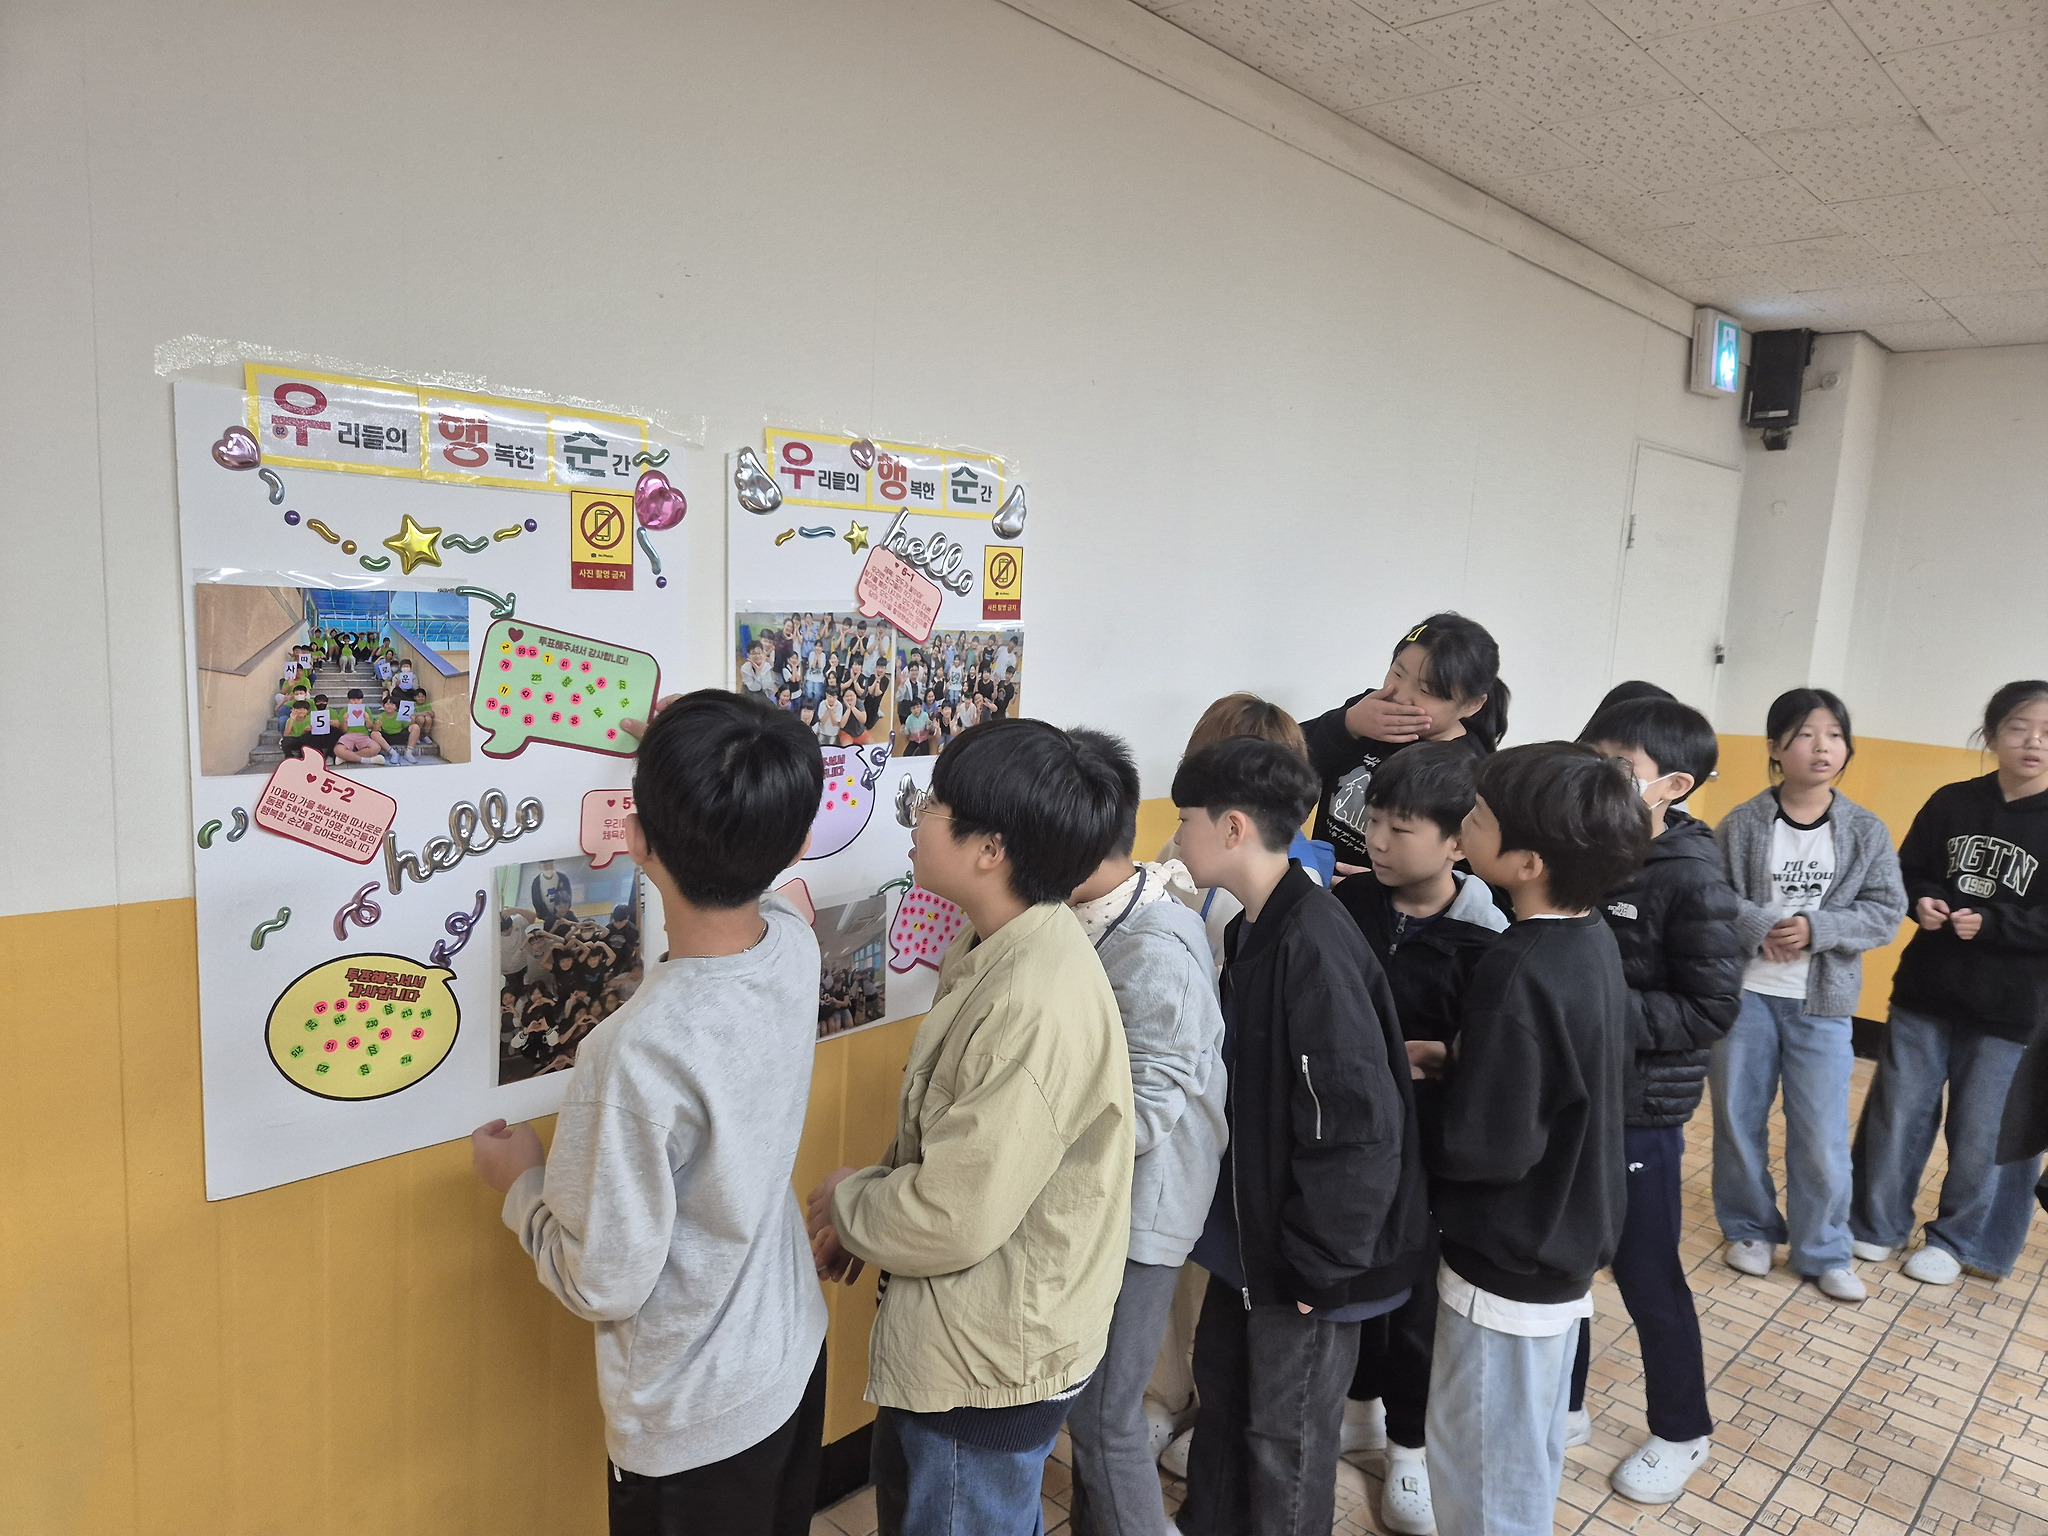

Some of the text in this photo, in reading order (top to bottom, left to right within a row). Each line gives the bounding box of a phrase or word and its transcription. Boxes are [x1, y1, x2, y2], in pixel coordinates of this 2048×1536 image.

[271, 383, 407, 453] 우리들의
[563, 431, 631, 478] 순간
[276, 426, 285, 435] 62
[780, 441, 992, 504] 우리들의 행복한 순간
[880, 507, 974, 597] hello
[579, 569, 626, 580] 사진 촬영 금지
[902, 567, 914, 582] 6-1
[286, 665, 296, 674] 사
[402, 674, 410, 684] 운
[402, 705, 410, 716] 2
[316, 716, 325, 728] 5
[320, 778, 355, 803] 5-2
[261, 805, 286, 821] 행복한
[288, 815, 312, 831] 순간을
[270, 785, 382, 835] 10월의 가을 햇살처럼 따사로운
[286, 803, 308, 817] 5학년
[310, 812, 323, 823] 2반
[325, 818, 342, 830] 19명
[344, 826, 376, 844] 친구들의
[383, 788, 544, 895] hello
[1806, 872, 1834, 880] you
[1964, 877, 1993, 896] 1960
[345, 968, 427, 988] 투표해주셔서
[348, 983, 420, 1002] 감사합니다
[401, 1009, 412, 1018] 213
[366, 1020, 378, 1028] 230
